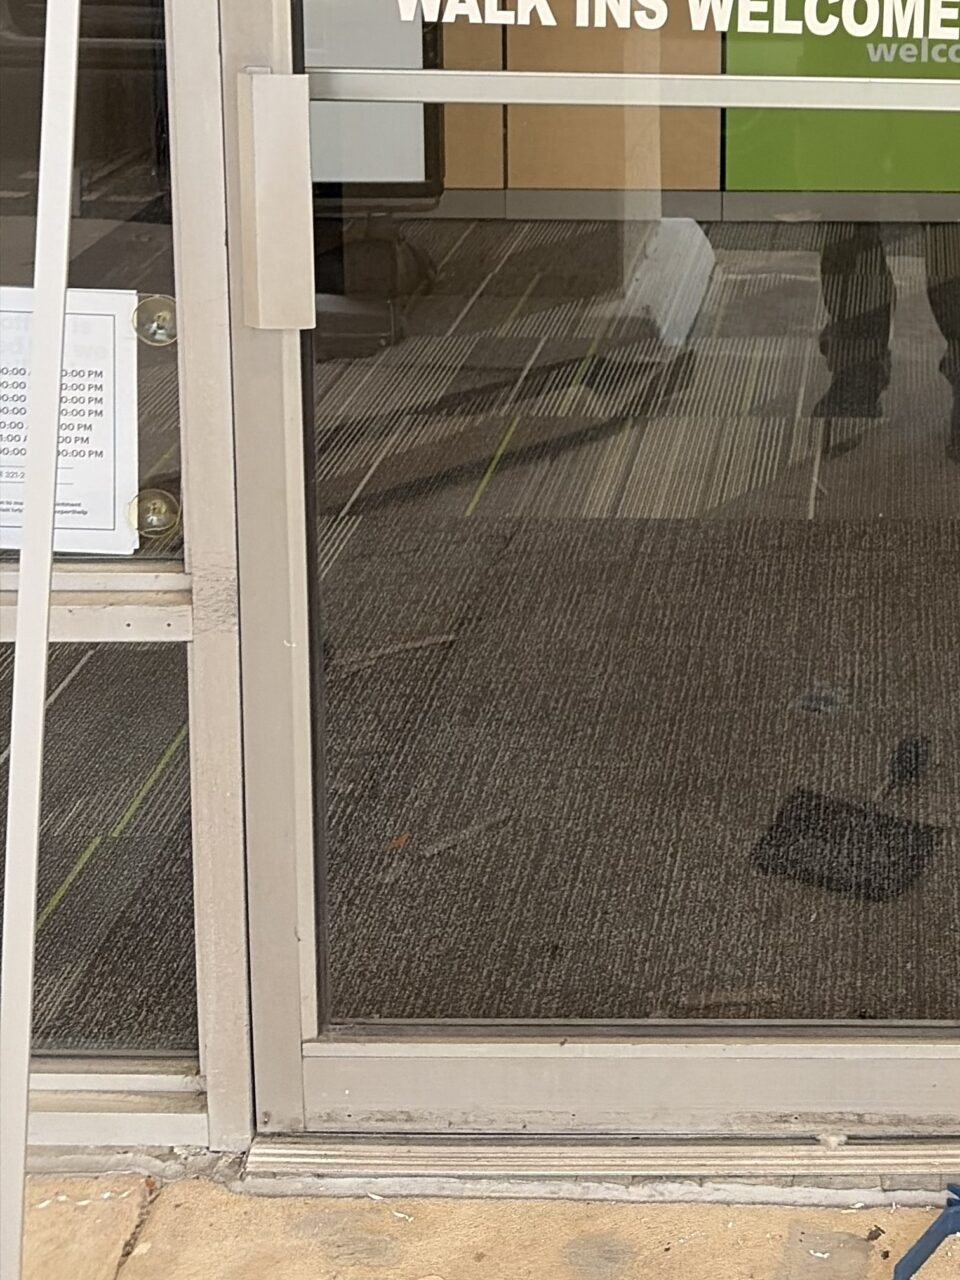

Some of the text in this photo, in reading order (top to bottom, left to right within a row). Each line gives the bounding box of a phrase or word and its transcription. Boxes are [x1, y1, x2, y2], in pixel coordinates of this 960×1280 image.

[88, 370, 103, 379] PM
[88, 383, 103, 392] PM
[88, 396, 103, 405] PM
[88, 409, 103, 417] PM
[60, 422, 75, 431] 00
[77, 423, 92, 431] PM
[58, 436, 72, 444] 00
[74, 436, 89, 444] PM
[88, 450, 104, 458] PM
